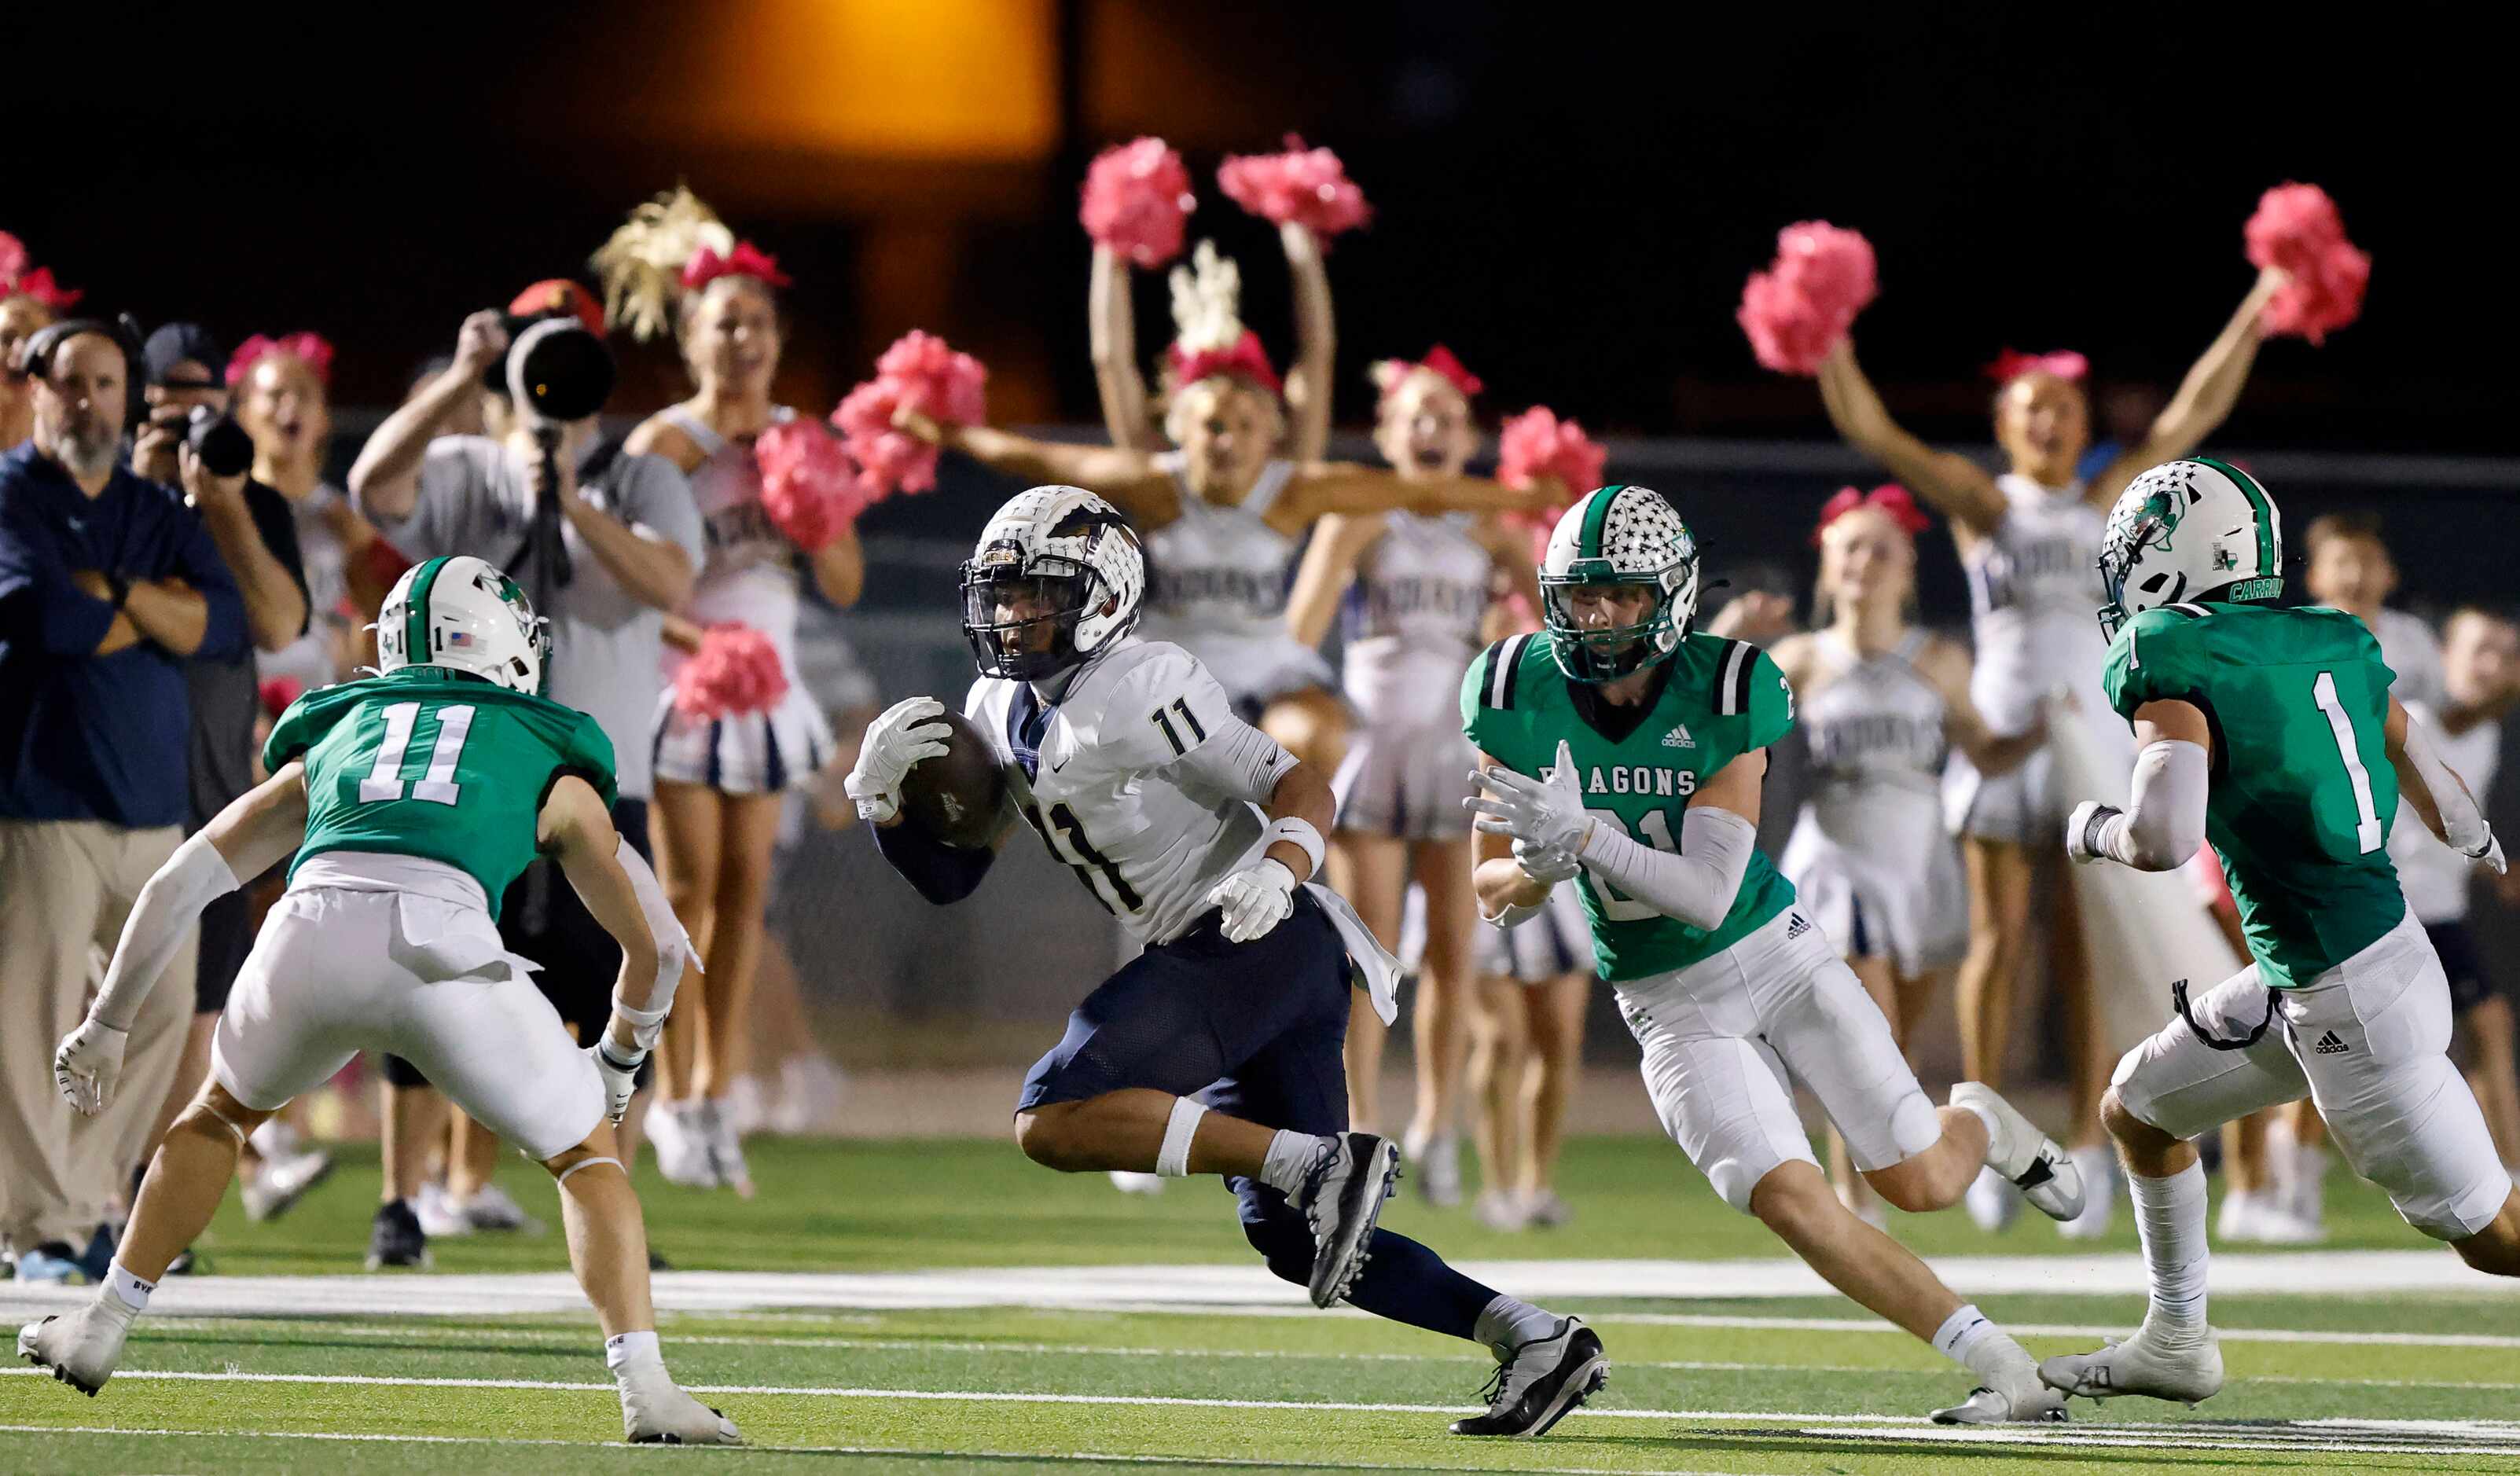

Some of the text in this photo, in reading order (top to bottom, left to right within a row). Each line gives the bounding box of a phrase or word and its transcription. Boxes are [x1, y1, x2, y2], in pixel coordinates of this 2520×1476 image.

[2129, 628, 2139, 670] 1
[1147, 694, 1207, 761] 11
[1662, 738, 1695, 748] adidas
[358, 701, 476, 806] 11
[2312, 670, 2382, 856] 1
[1538, 766, 1695, 795] AGONS
[2316, 1044, 2349, 1054] adidas
